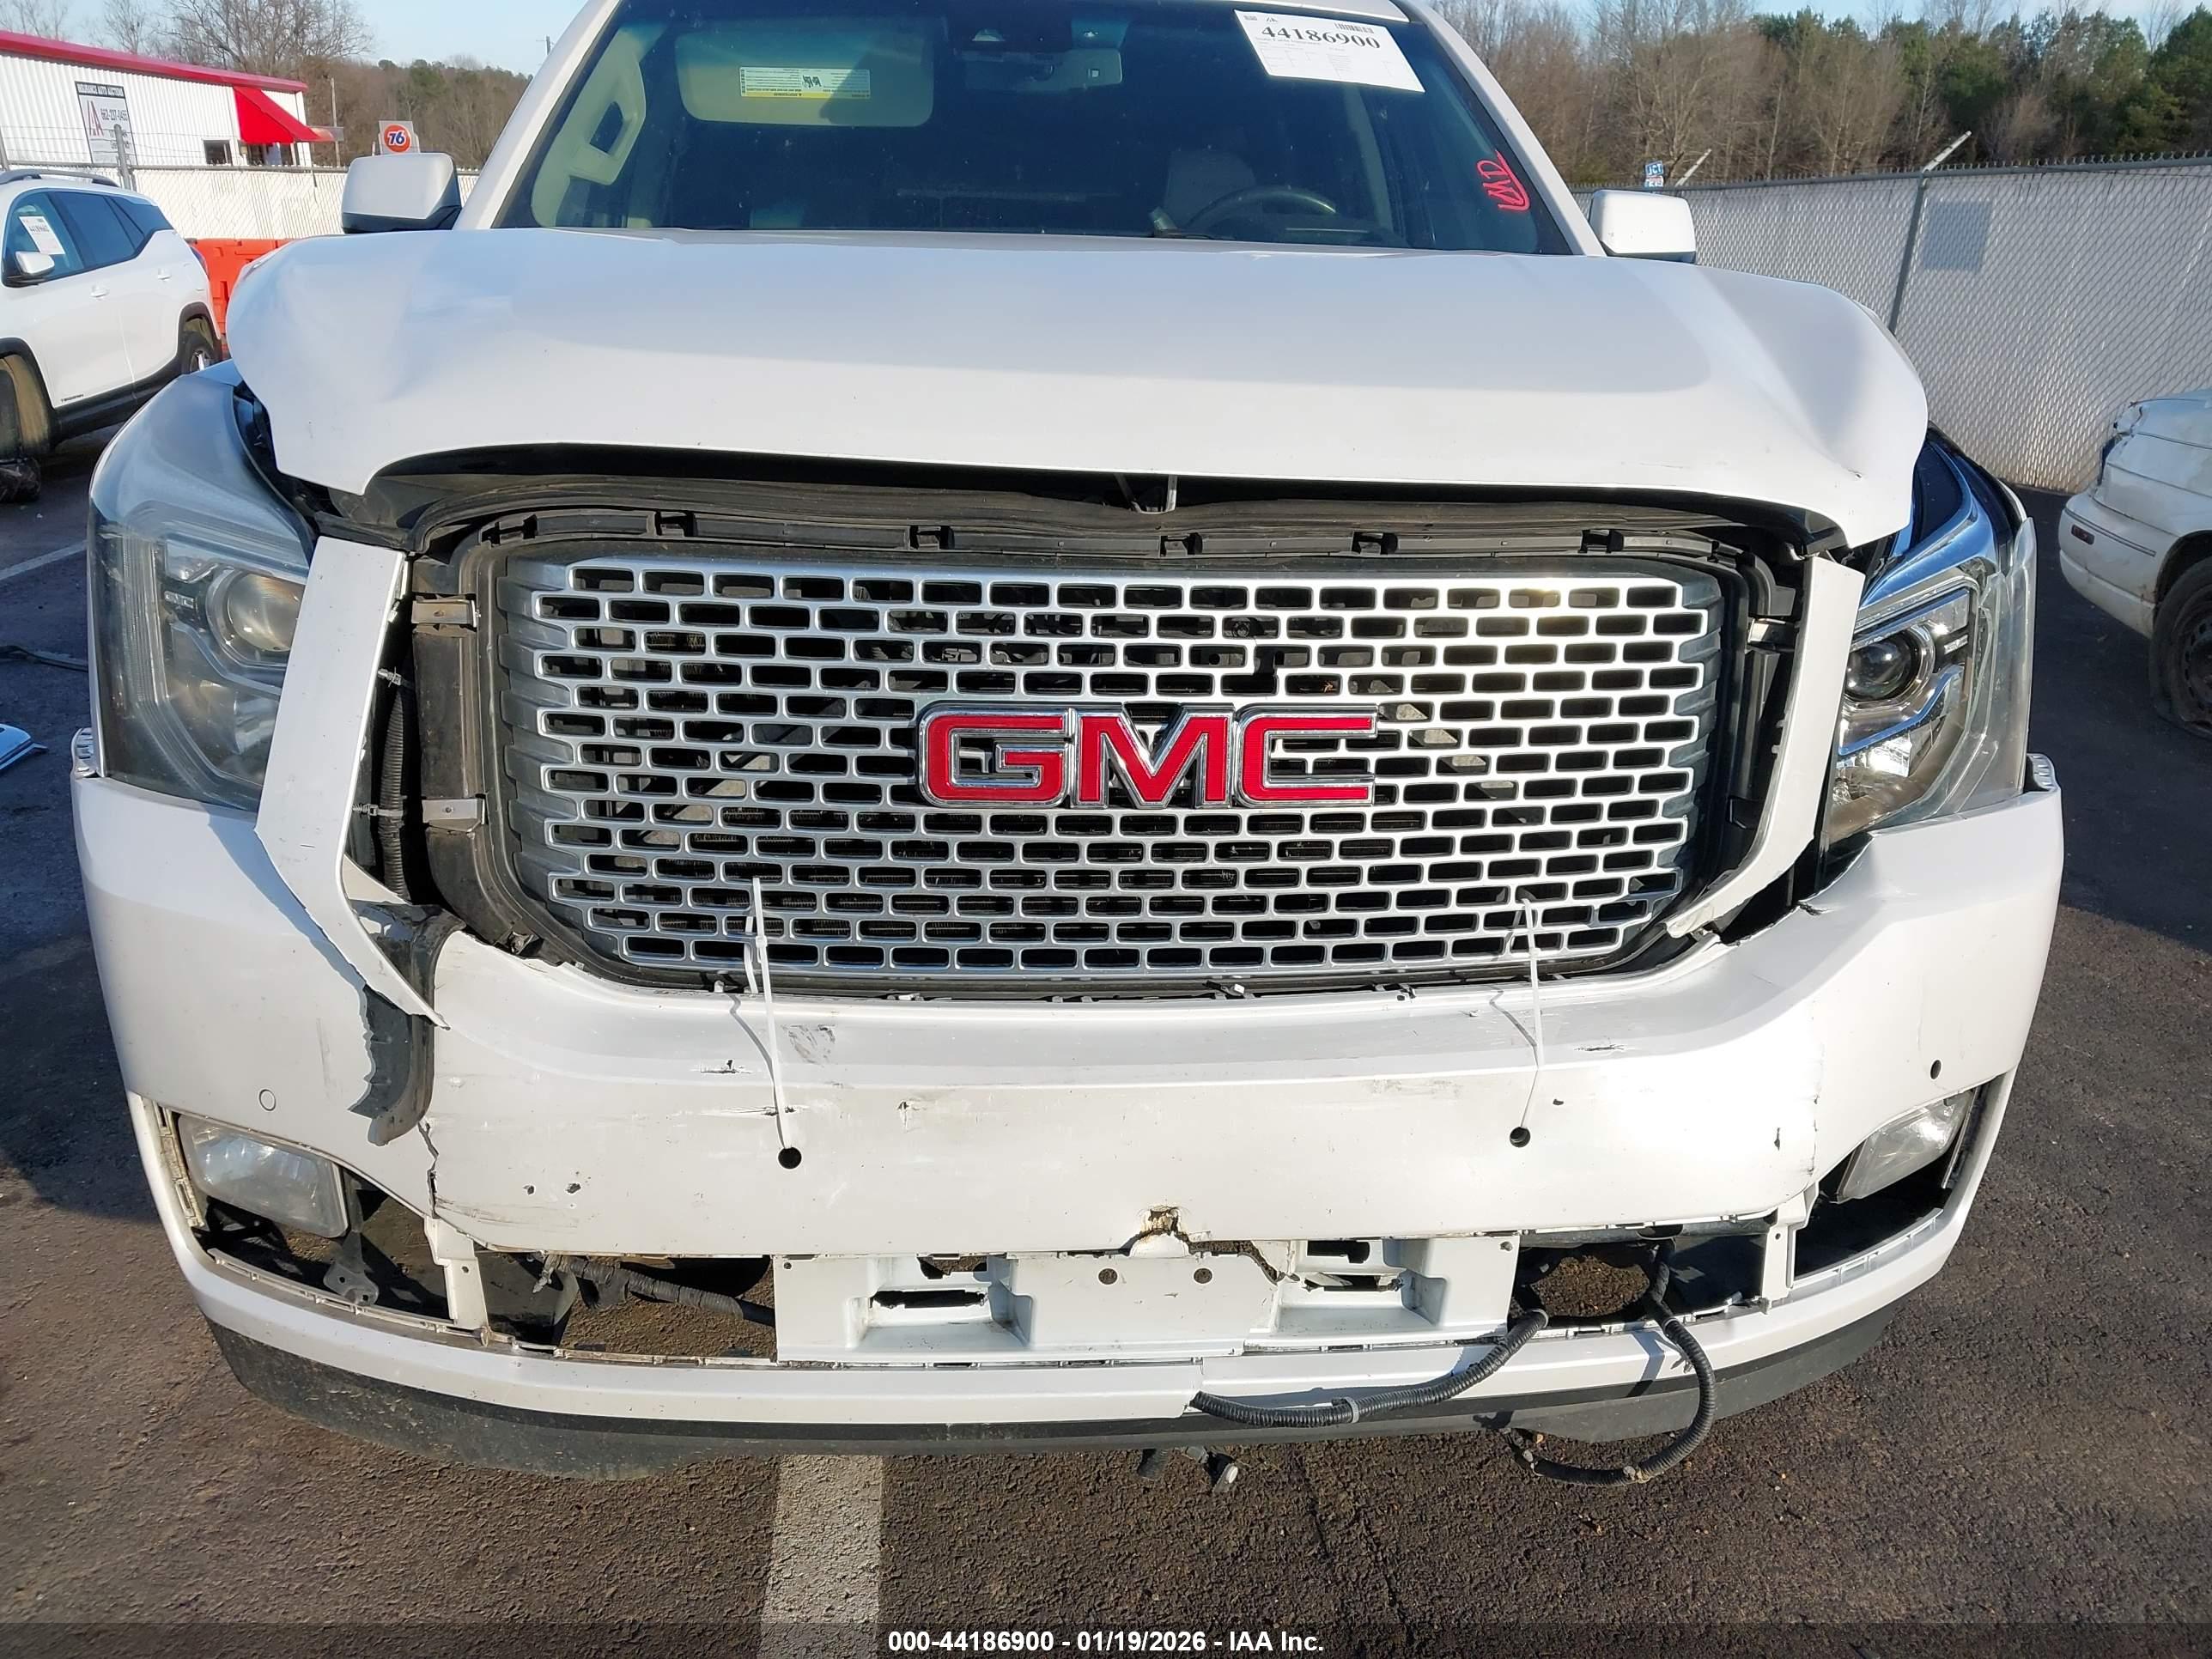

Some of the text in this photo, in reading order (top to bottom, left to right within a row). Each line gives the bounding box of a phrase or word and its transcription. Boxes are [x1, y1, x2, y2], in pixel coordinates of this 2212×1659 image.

[1261, 26, 1380, 49] 44186900
[387, 130, 406, 146] 76
[1647, 162, 1663, 175] JCT
[919, 702, 1378, 809] GMC
